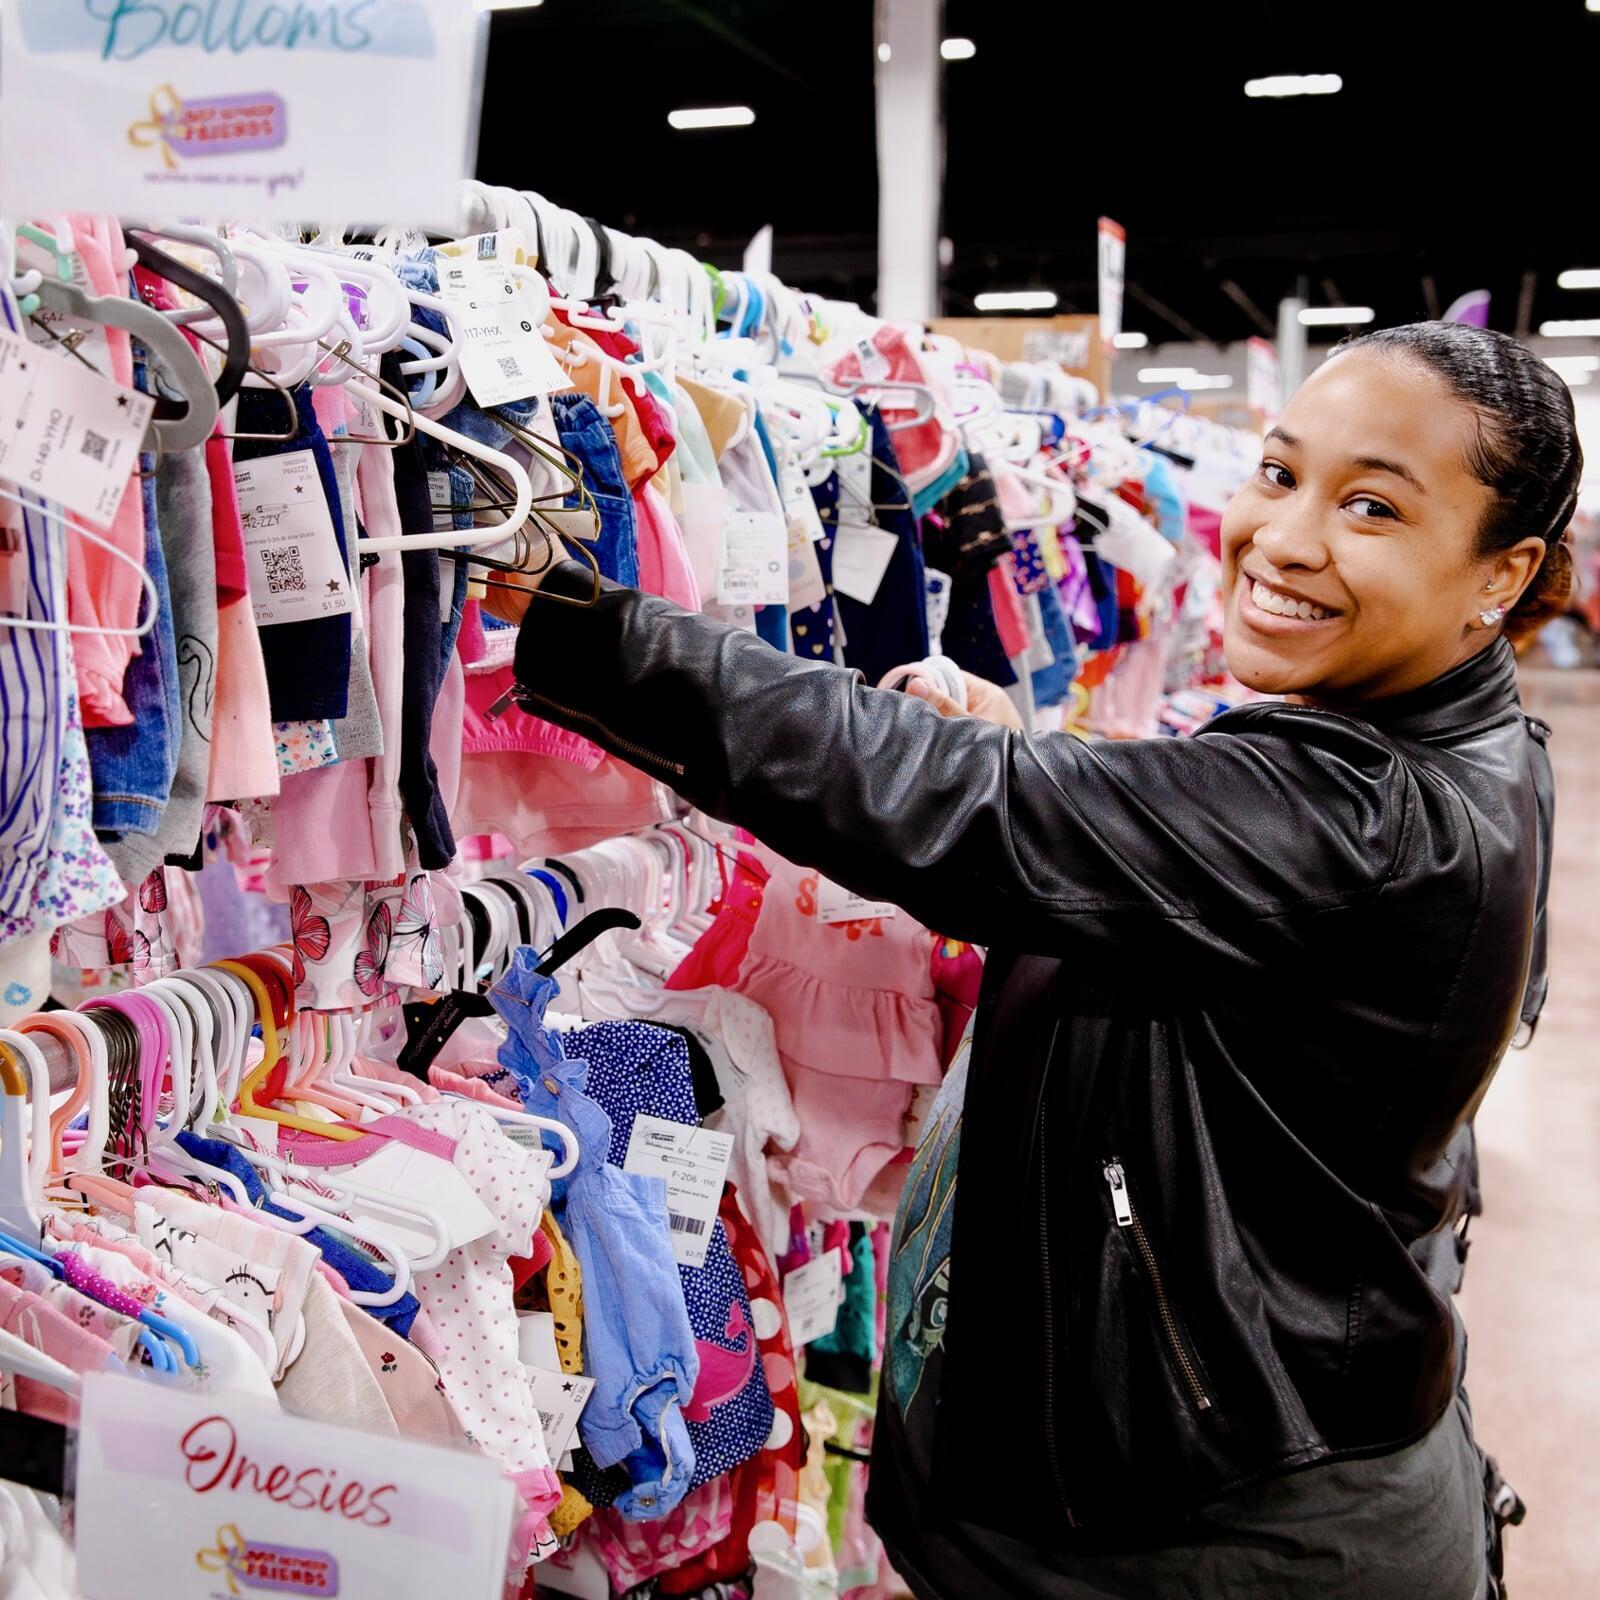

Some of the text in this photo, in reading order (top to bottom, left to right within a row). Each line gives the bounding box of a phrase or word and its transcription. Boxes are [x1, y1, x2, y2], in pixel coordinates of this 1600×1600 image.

[321, 599, 346, 610] $1.50
[671, 1170, 698, 1184] F-206
[179, 1415, 398, 1528] Onesies
[245, 1562, 327, 1588] FRIENDS
